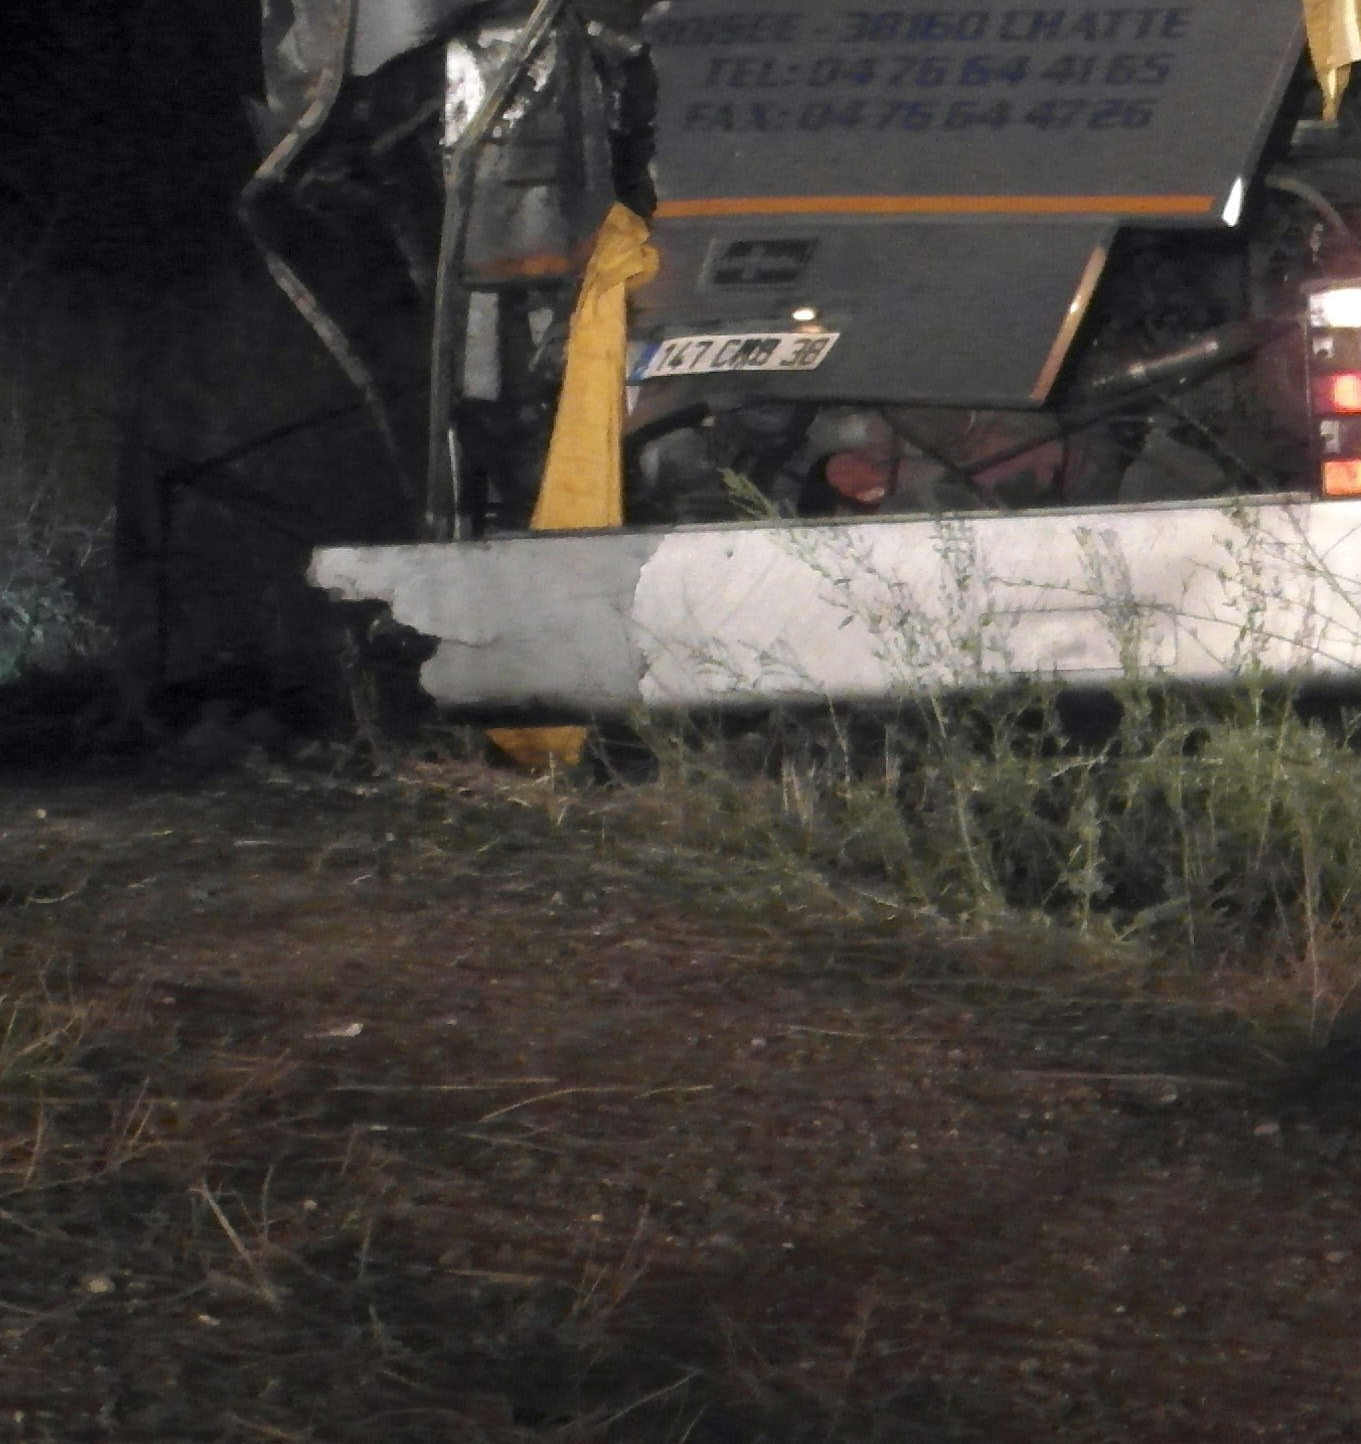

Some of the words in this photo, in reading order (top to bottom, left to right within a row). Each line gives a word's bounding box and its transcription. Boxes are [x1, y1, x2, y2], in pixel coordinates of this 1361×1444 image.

[838, 9, 992, 43] 38160
[998, 6, 1195, 43] CHATTE
[704, 54, 799, 90] TEL:
[681, 99, 790, 133] FAX:
[656, 340, 714, 372] 147
[779, 337, 832, 367] 38
